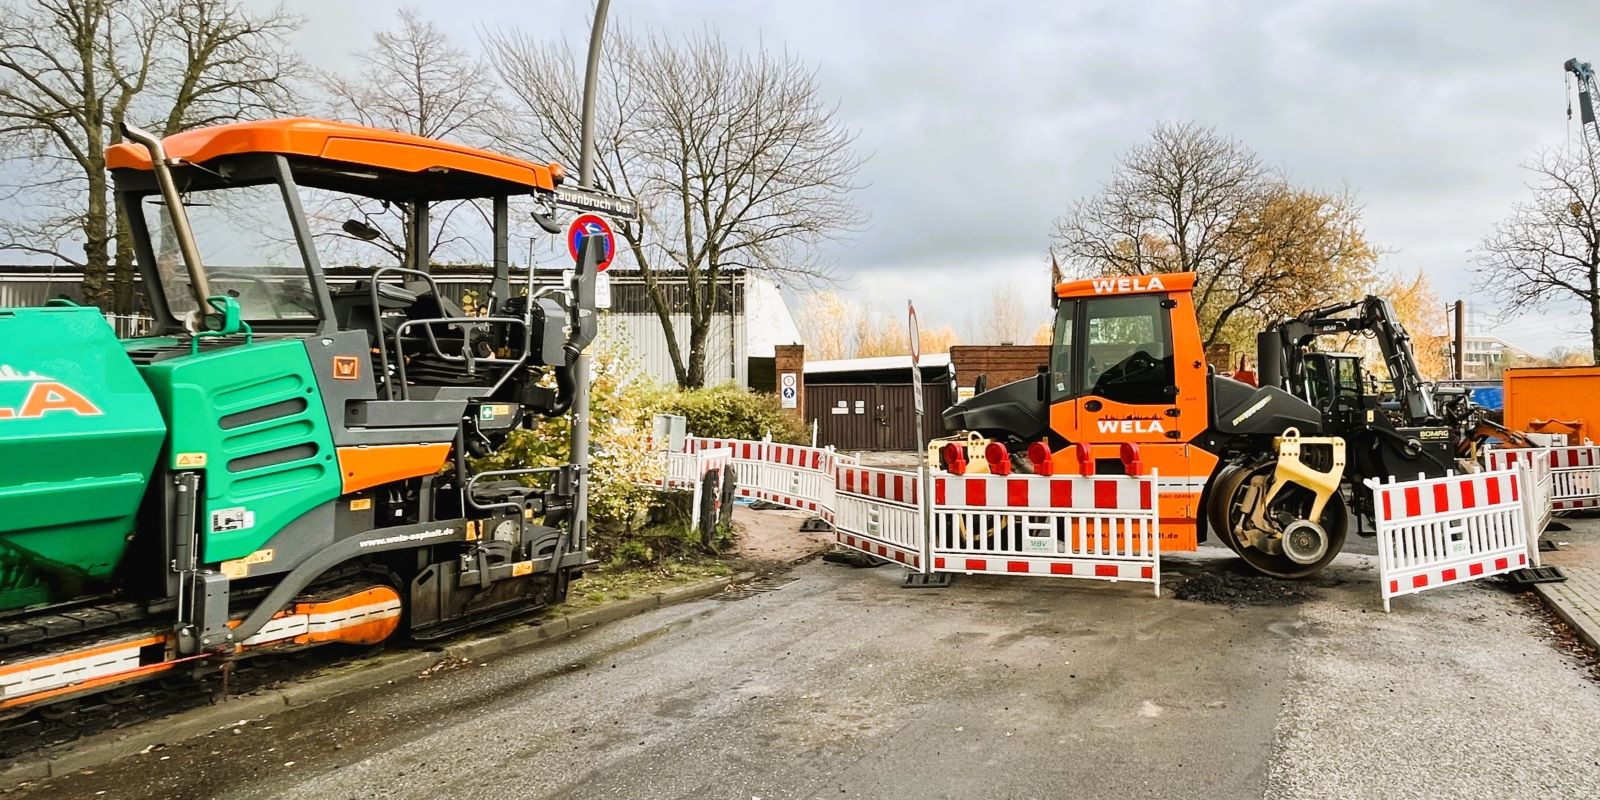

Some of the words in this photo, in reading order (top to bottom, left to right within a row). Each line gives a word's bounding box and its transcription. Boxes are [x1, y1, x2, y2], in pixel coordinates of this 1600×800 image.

[615, 201, 630, 214] Ost
[1092, 276, 1165, 294] WELA
[0, 382, 104, 419] A
[1097, 420, 1164, 433] WELA
[1420, 430, 1449, 438] BOMAG
[360, 528, 454, 548] www.wela-asphalt.de
